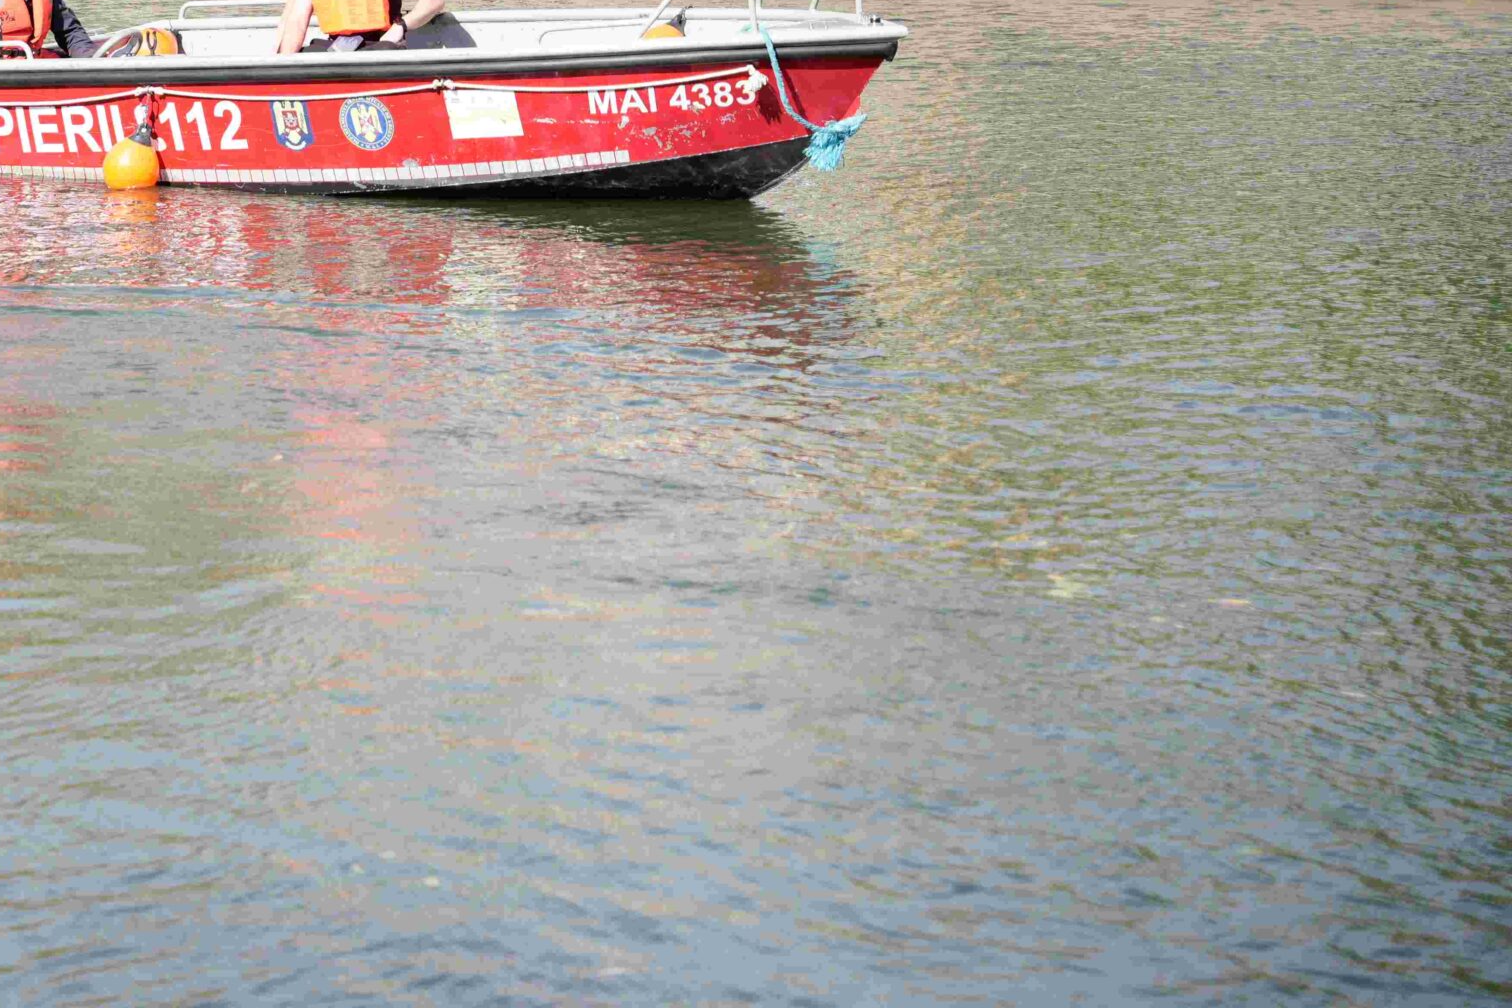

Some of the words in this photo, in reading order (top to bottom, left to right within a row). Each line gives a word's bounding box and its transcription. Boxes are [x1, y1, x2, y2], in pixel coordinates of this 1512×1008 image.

[587, 86, 658, 115] MAI
[669, 80, 756, 111] 4383
[158, 100, 249, 151] 112
